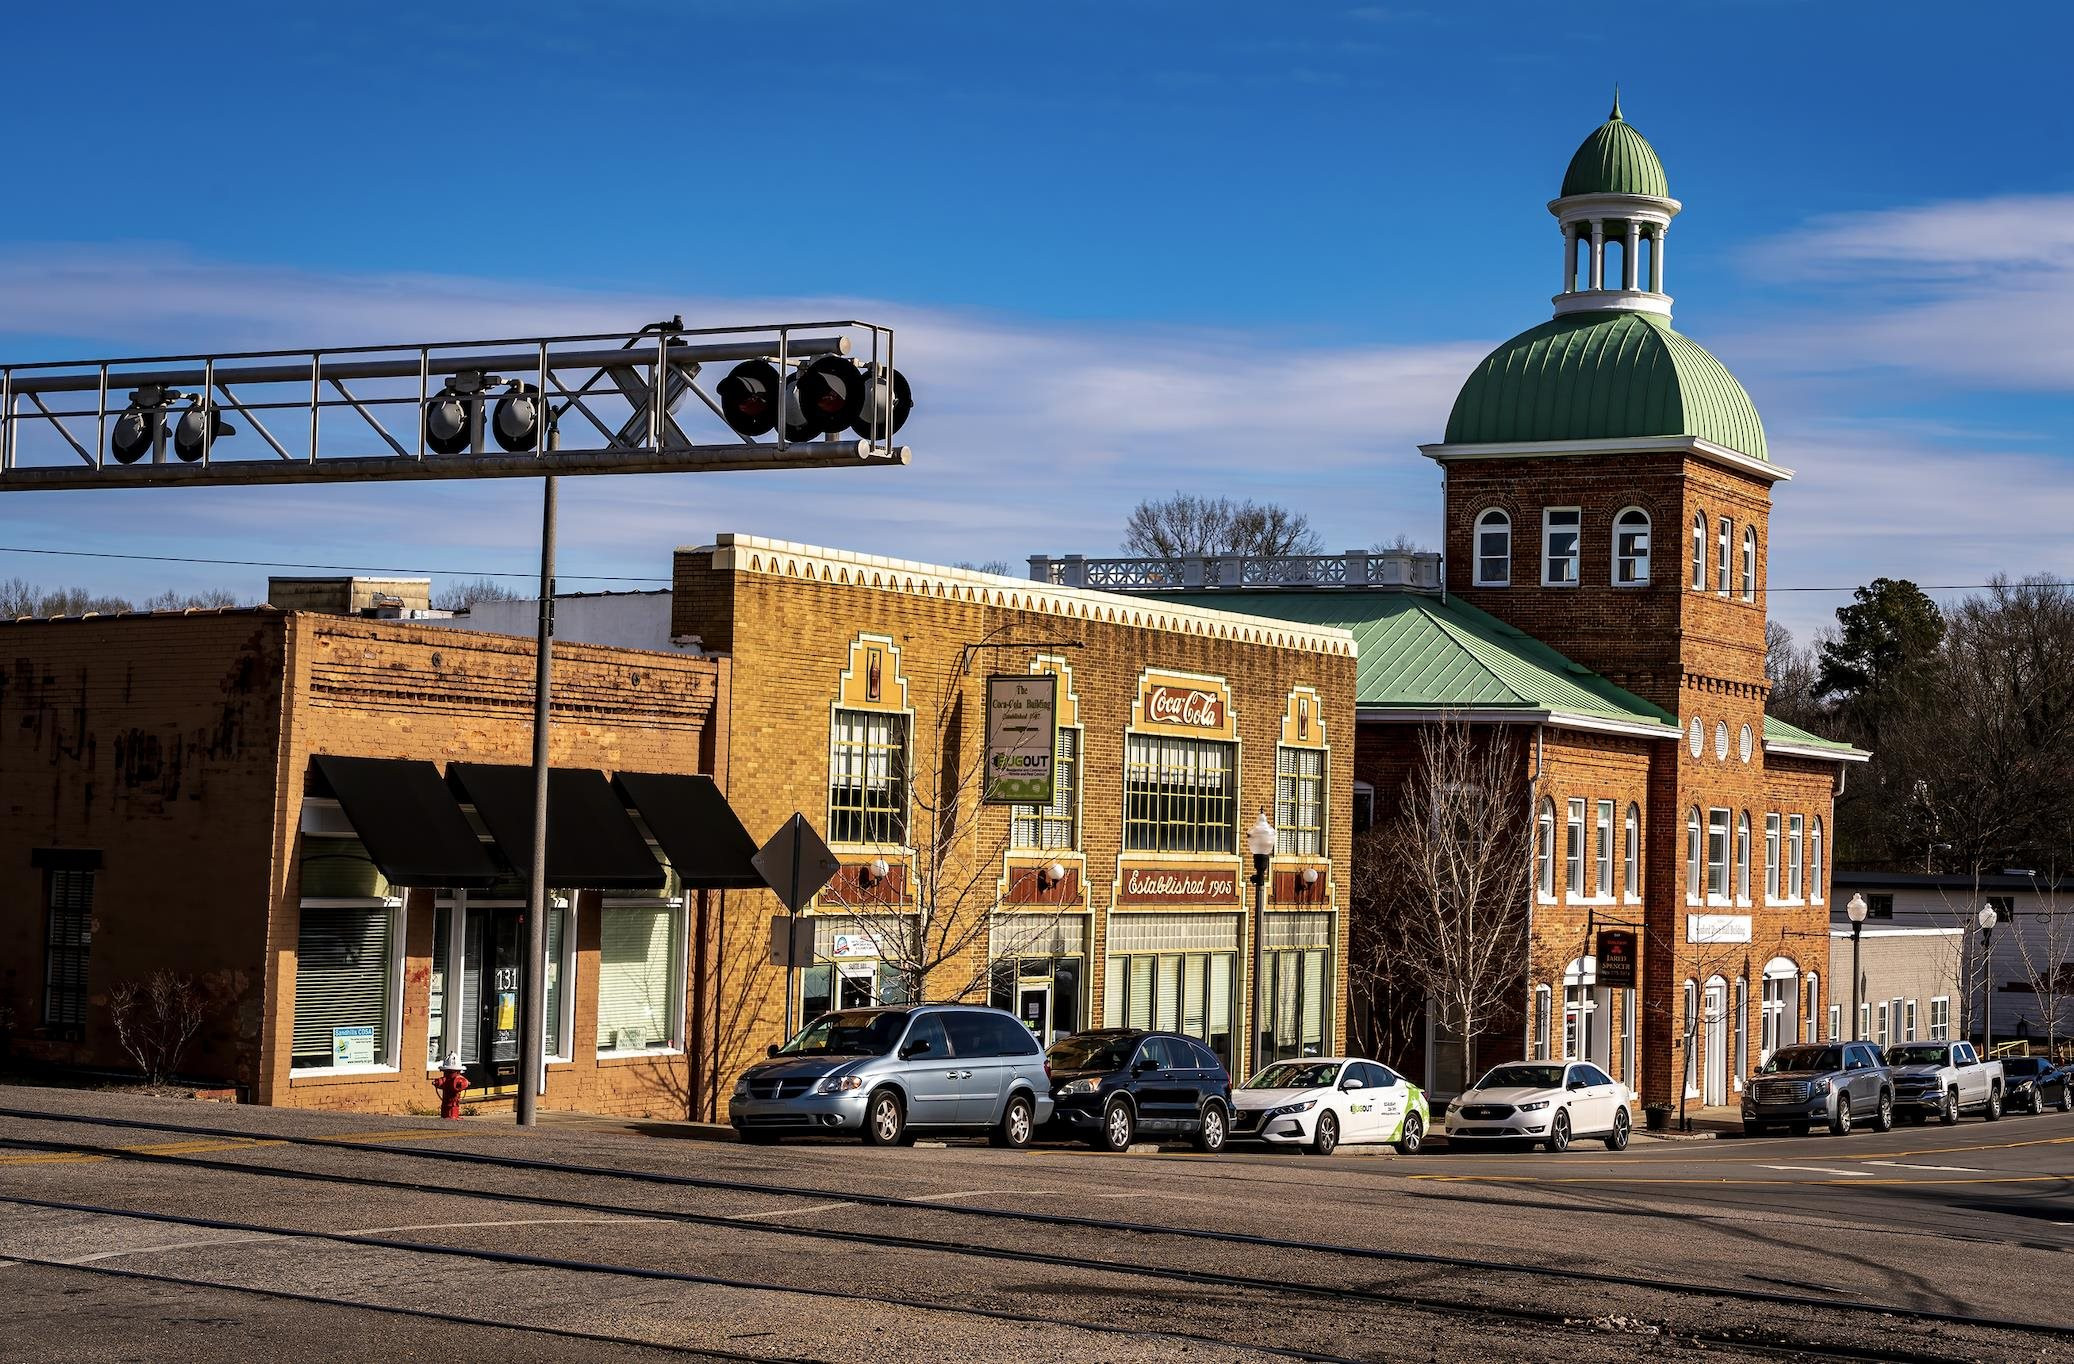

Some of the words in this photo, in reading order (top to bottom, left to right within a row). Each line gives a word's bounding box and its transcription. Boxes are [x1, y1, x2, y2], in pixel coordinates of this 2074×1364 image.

[1016, 685, 1028, 695] The
[992, 699, 1022, 709] Coca-Cola
[1026, 699, 1051, 711] Building
[1128, 869, 1205, 895] Established
[1207, 880, 1233, 898] 1905
[496, 968, 518, 990] 131
